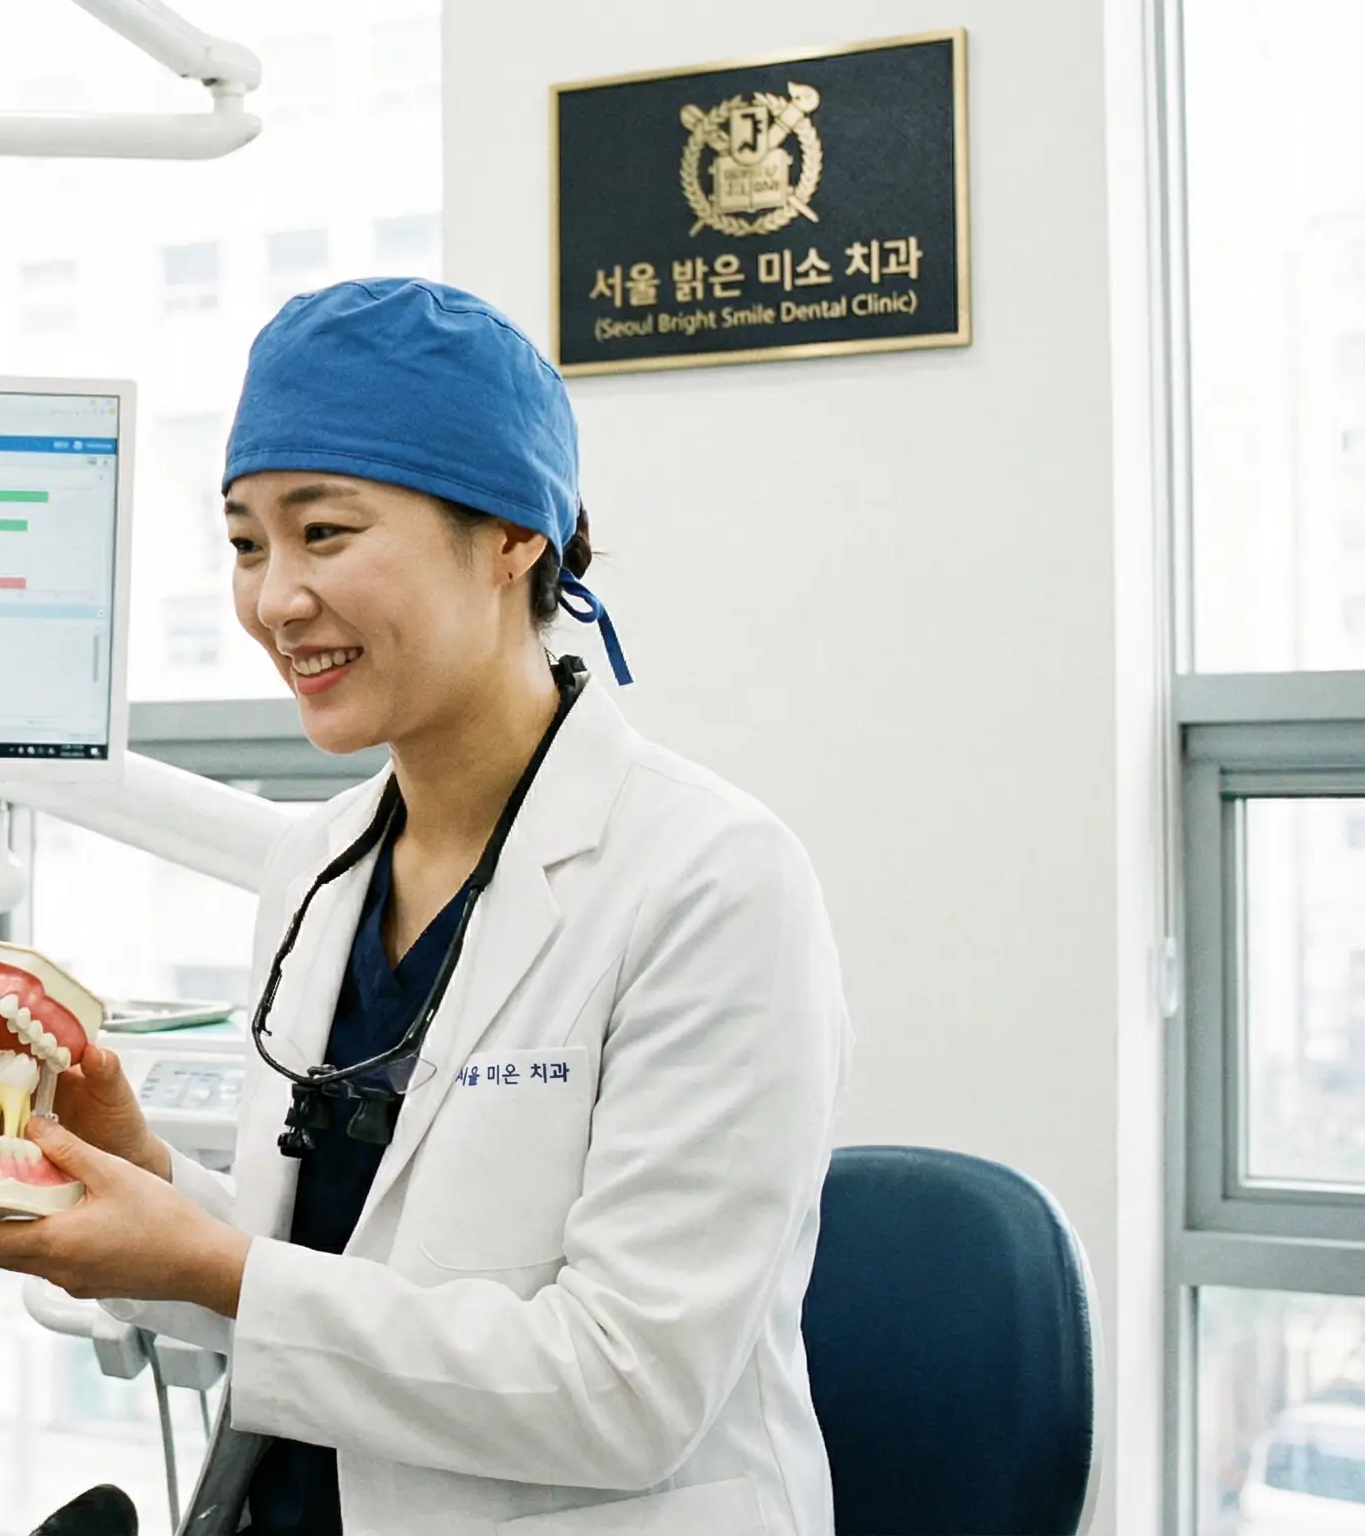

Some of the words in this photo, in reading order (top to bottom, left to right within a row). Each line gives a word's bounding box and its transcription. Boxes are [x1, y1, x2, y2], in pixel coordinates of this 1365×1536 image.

[590, 262, 661, 308] 서울
[673, 255, 745, 300] 밝은
[759, 248, 832, 291] 미소
[845, 237, 922, 284] 치과
[595, 316, 654, 342] (Seoul
[658, 307, 717, 337] Bright
[723, 303, 775, 328] Smile
[781, 298, 847, 323] Dental
[852, 290, 918, 316] Clinic)
[487, 1064, 520, 1085] 미온
[530, 1062, 570, 1083] 치과
